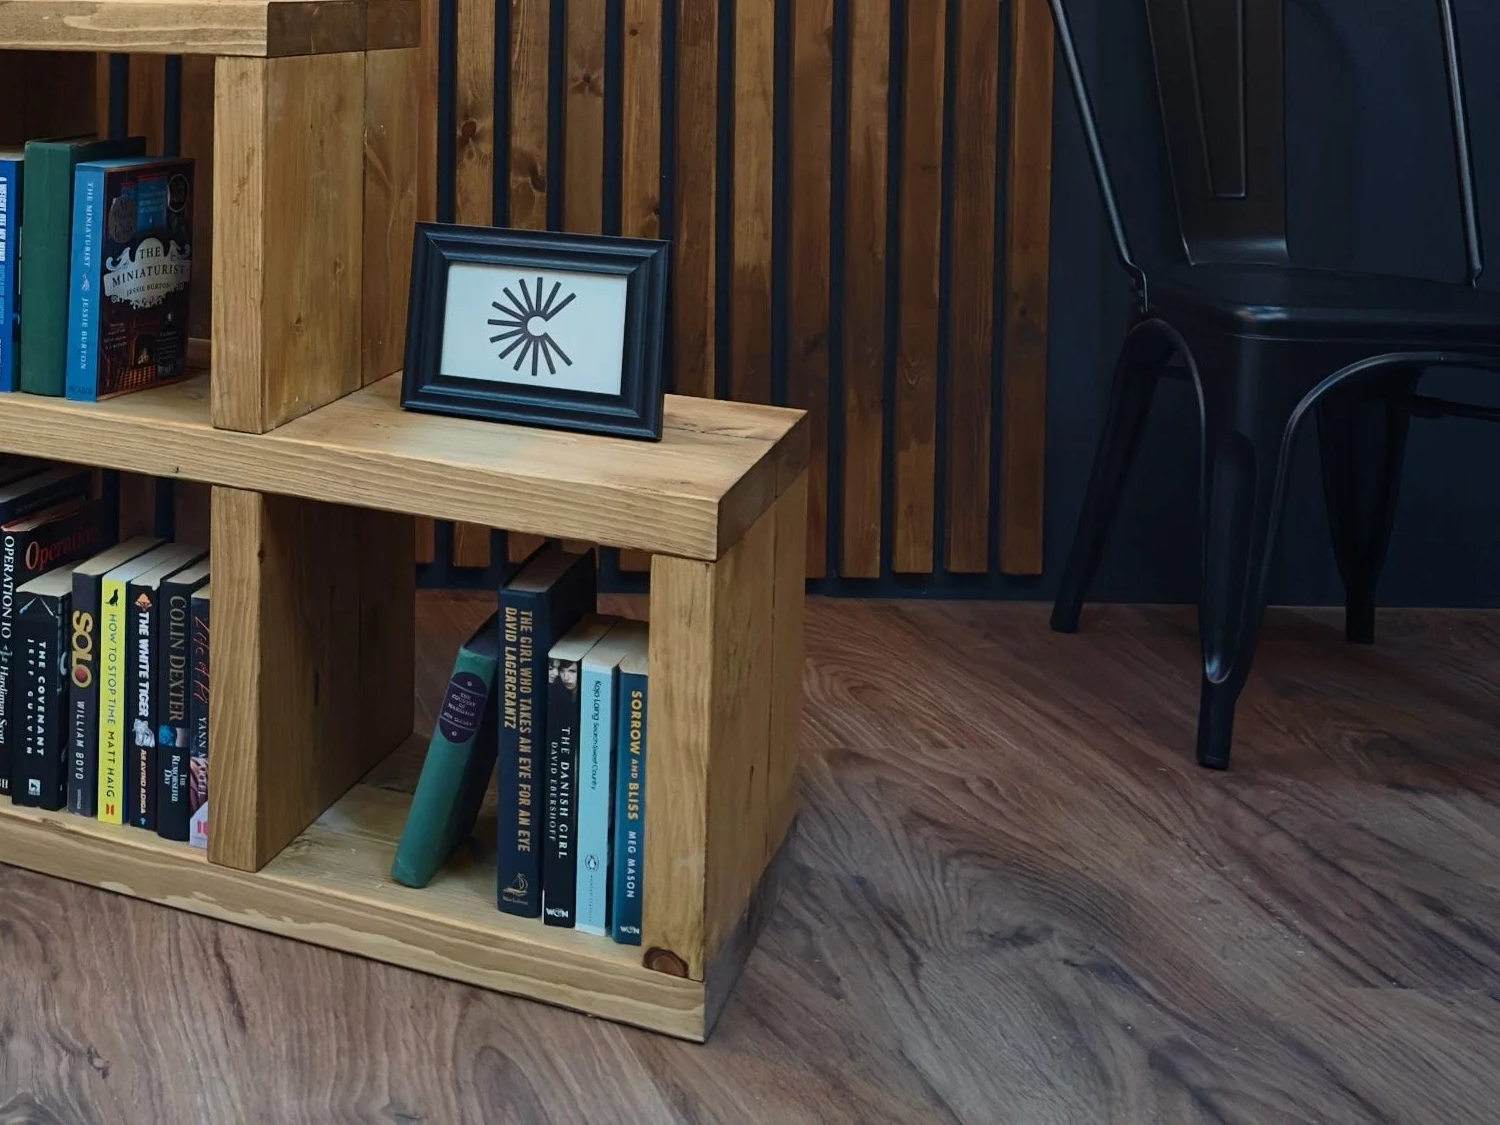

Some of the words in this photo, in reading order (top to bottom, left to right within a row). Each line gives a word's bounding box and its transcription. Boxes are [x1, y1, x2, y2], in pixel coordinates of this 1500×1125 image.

[86, 182, 94, 201] THE
[83, 205, 93, 267] MINIATURIST
[140, 246, 161, 259] THE
[111, 263, 186, 288] MINIATURIST
[81, 298, 89, 327] JESSIE
[79, 330, 88, 369] BURTON
[2, 535, 15, 616] OPERATION
[109, 613, 117, 643] HOW
[139, 612, 149, 635] THE
[169, 595, 187, 649] COLIN
[505, 607, 518, 642] DAVID
[519, 610, 533, 633] THE
[71, 610, 93, 688] SOLO
[109, 647, 117, 662] TO
[139, 638, 149, 678] WHITE
[519, 635, 533, 663] GIRL
[108, 665, 117, 696] STOP
[169, 654, 187, 721] DEXTER
[504, 645, 518, 729] LAGERCRANTZ
[519, 667, 533, 694] WHO
[592, 680, 602, 697] Kojo
[107, 698, 116, 724] TIME
[139, 681, 149, 716] TIGER
[37, 675, 46, 755] COVENANT
[76, 700, 85, 747] WILLIAM
[198, 715, 207, 746] YANN
[519, 698, 532, 733] TAKES
[630, 690, 642, 755] SORROW
[107, 731, 116, 764] MATT
[519, 736, 531, 753] AN
[561, 726, 570, 754] THE
[75, 752, 84, 780] BOYD
[198, 751, 208, 796] MARTEL
[518, 757, 531, 778] EYE
[631, 758, 639, 779] AND
[106, 767, 114, 797] HAIG
[518, 783, 530, 806] FOR
[559, 761, 570, 816] DANISH
[549, 779, 557, 841] EBERSHOFF
[628, 782, 639, 820] BLISS
[518, 809, 530, 825] AN
[517, 829, 530, 852] EYE
[558, 823, 569, 859] GIRL
[627, 830, 636, 853] MEG
[626, 857, 636, 897] MASON
